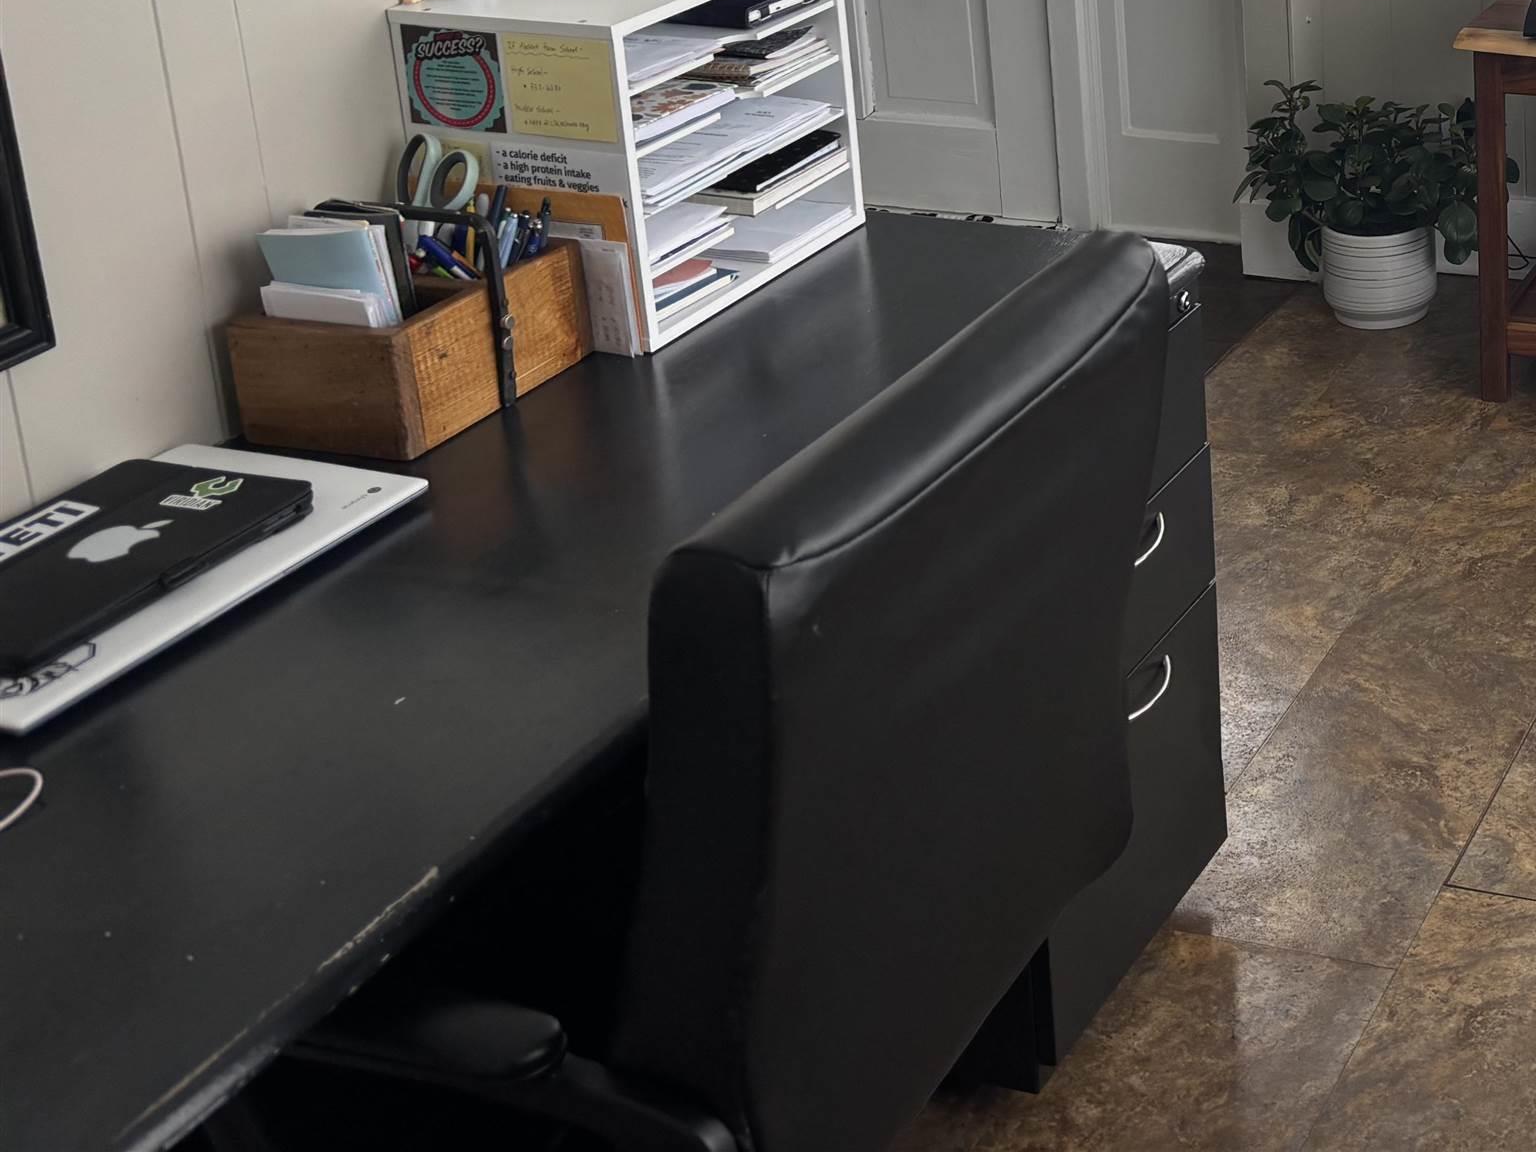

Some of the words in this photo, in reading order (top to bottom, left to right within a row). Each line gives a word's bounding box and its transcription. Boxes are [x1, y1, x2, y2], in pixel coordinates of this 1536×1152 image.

[417, 36, 483, 58] SUCCESS?
[509, 149, 538, 160] calorie
[540, 151, 567, 164] deficit
[510, 161, 530, 173] high
[531, 163, 562, 177] protein
[564, 167, 591, 179] intake
[504, 173, 532, 186] eating
[533, 174, 557, 187] fruits
[559, 179, 566, 188] &
[567, 181, 600, 193] veggies
[0, 506, 86, 557] ETI
